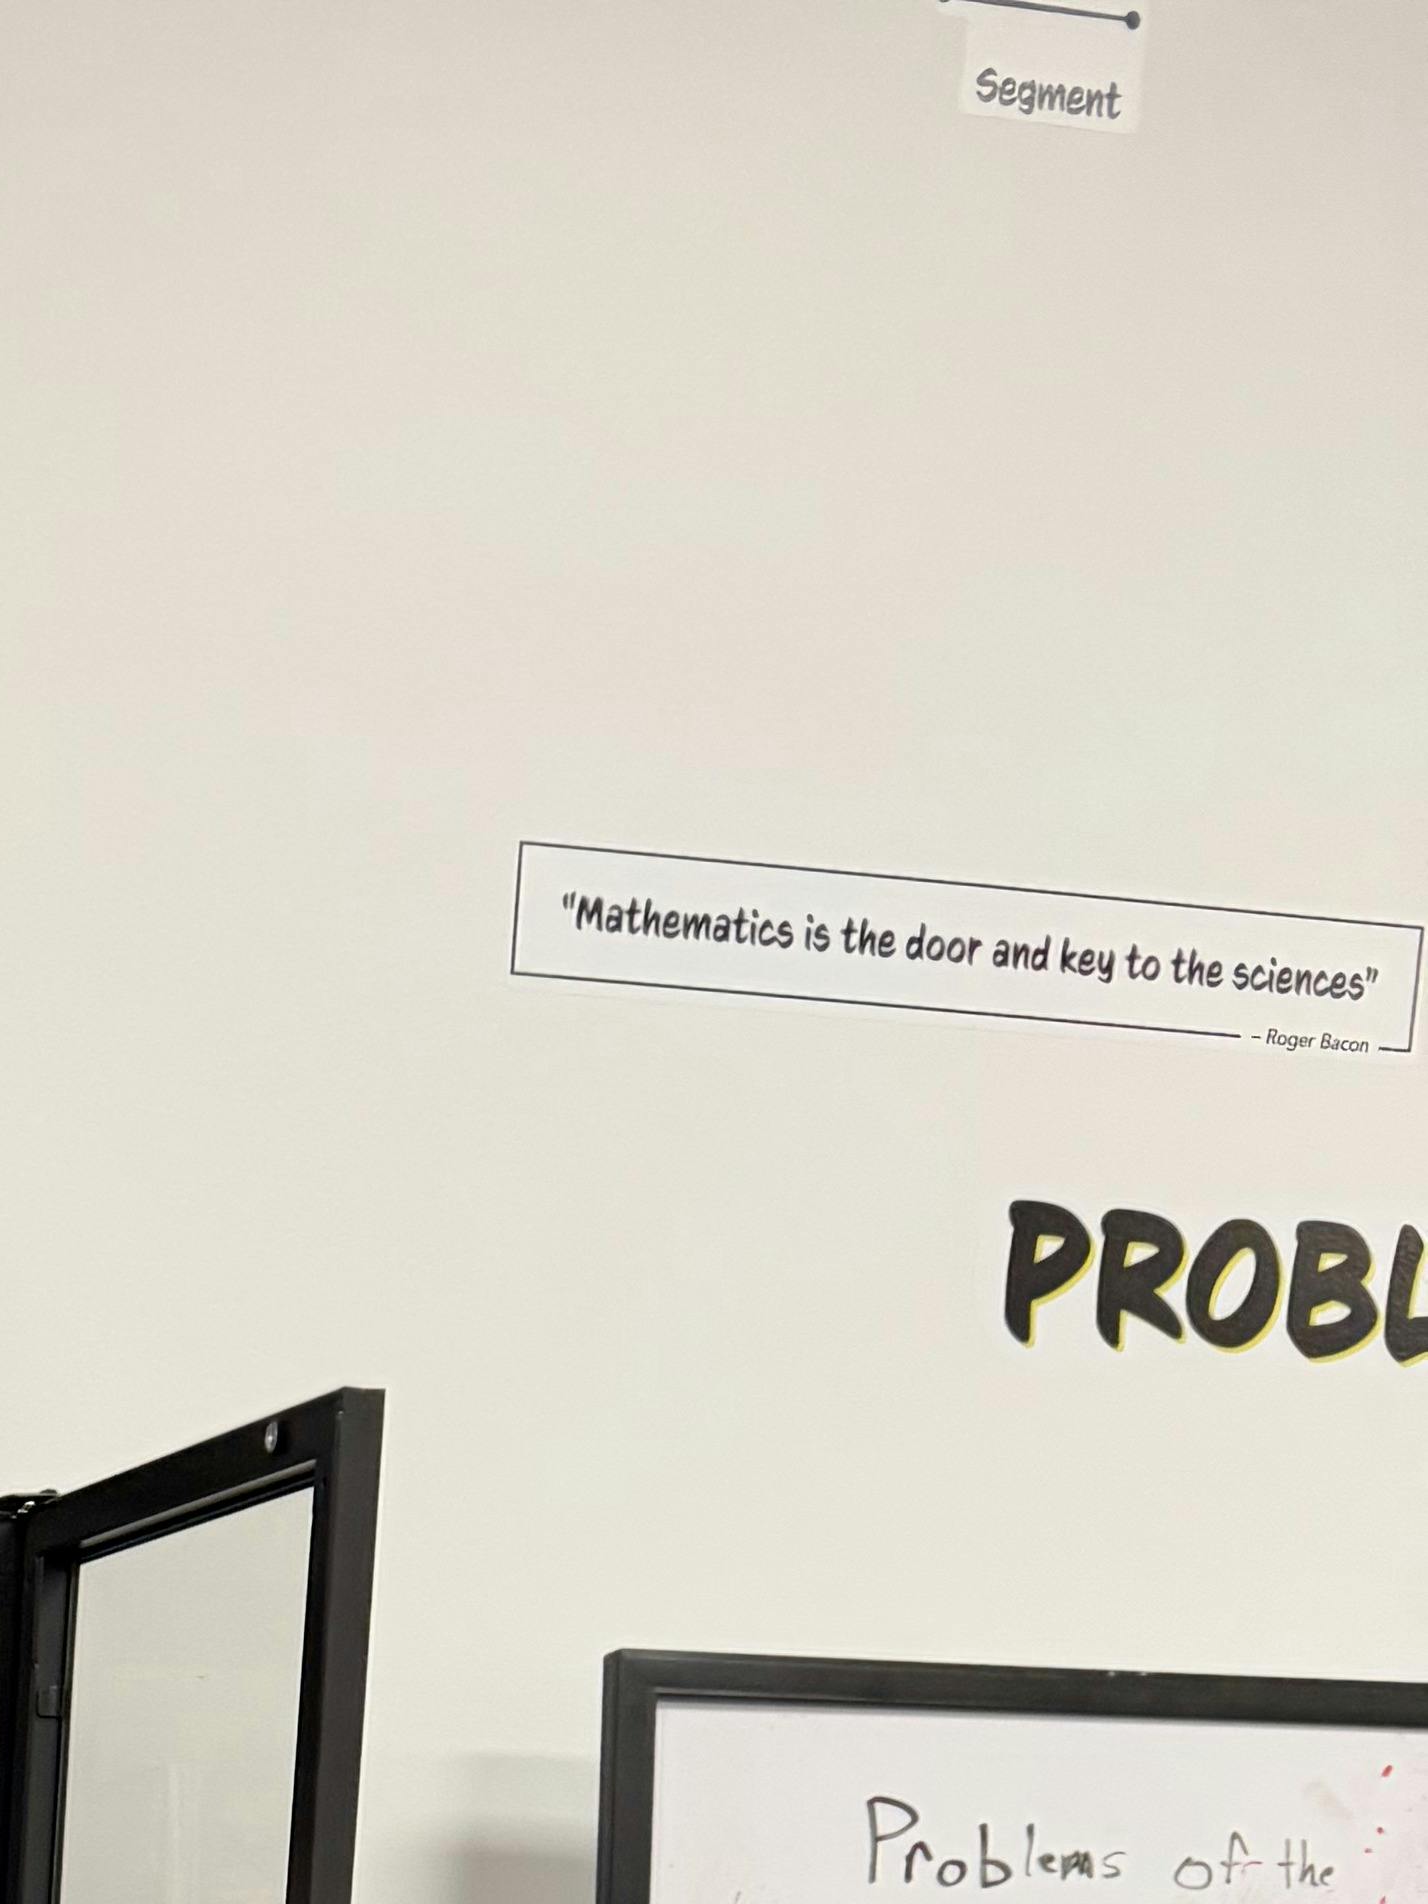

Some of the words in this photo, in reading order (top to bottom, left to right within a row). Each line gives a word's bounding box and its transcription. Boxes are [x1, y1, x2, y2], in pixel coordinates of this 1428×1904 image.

[974, 66, 1123, 121] Segment
[561, 890, 795, 950] "Mathematics
[803, 912, 831, 954] is
[839, 916, 897, 959] the
[904, 921, 984, 967] door
[991, 933, 1052, 972] and
[1058, 936, 1116, 985] key
[1124, 942, 1162, 982] to
[1169, 946, 1224, 989] the
[1231, 955, 1380, 1002] sciences"
[1265, 1027, 1317, 1053] Roger
[1319, 1031, 1370, 1054] Bacon
[865, 1795, 1127, 1890] Problems
[1171, 1851, 1264, 1890] of
[1273, 1836, 1338, 1890] the
